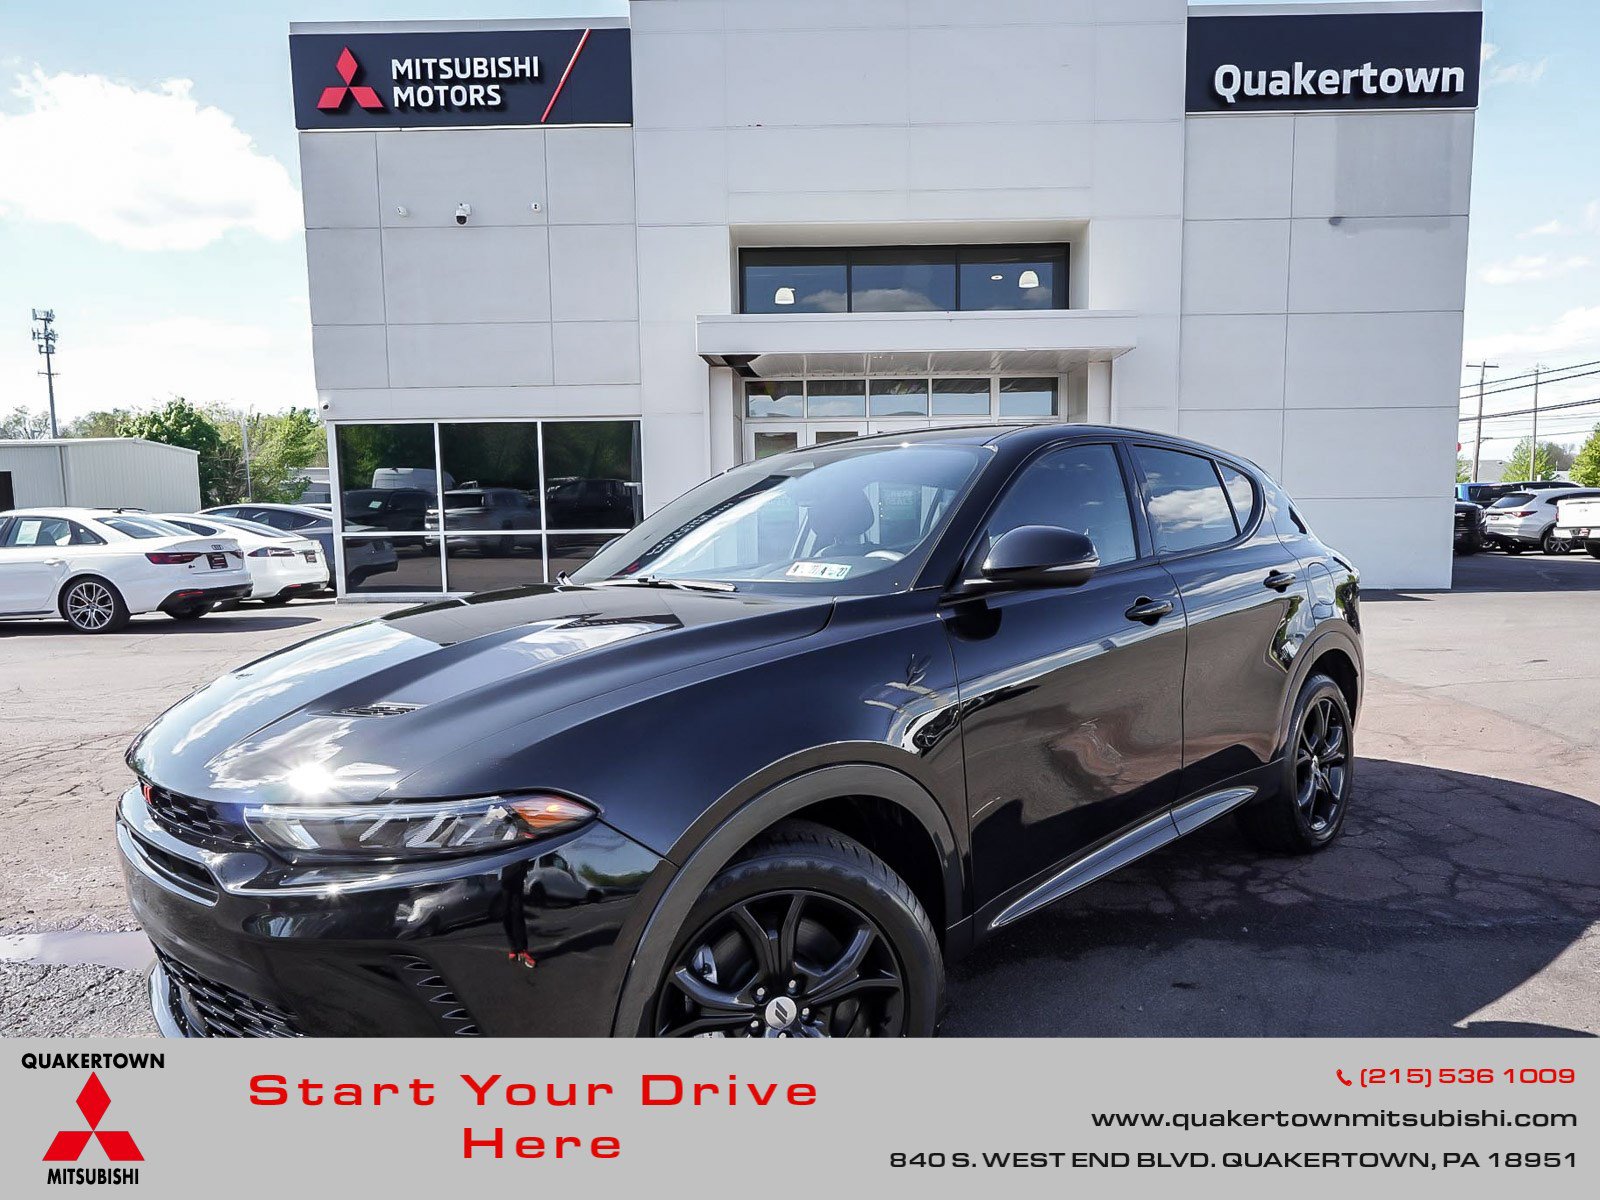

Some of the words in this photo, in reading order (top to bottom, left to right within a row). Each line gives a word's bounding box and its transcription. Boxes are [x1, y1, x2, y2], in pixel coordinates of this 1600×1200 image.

[391, 55, 539, 80] MITSUBISHI
[1214, 61, 1465, 104] Quakertown
[393, 84, 502, 108] MOTORS
